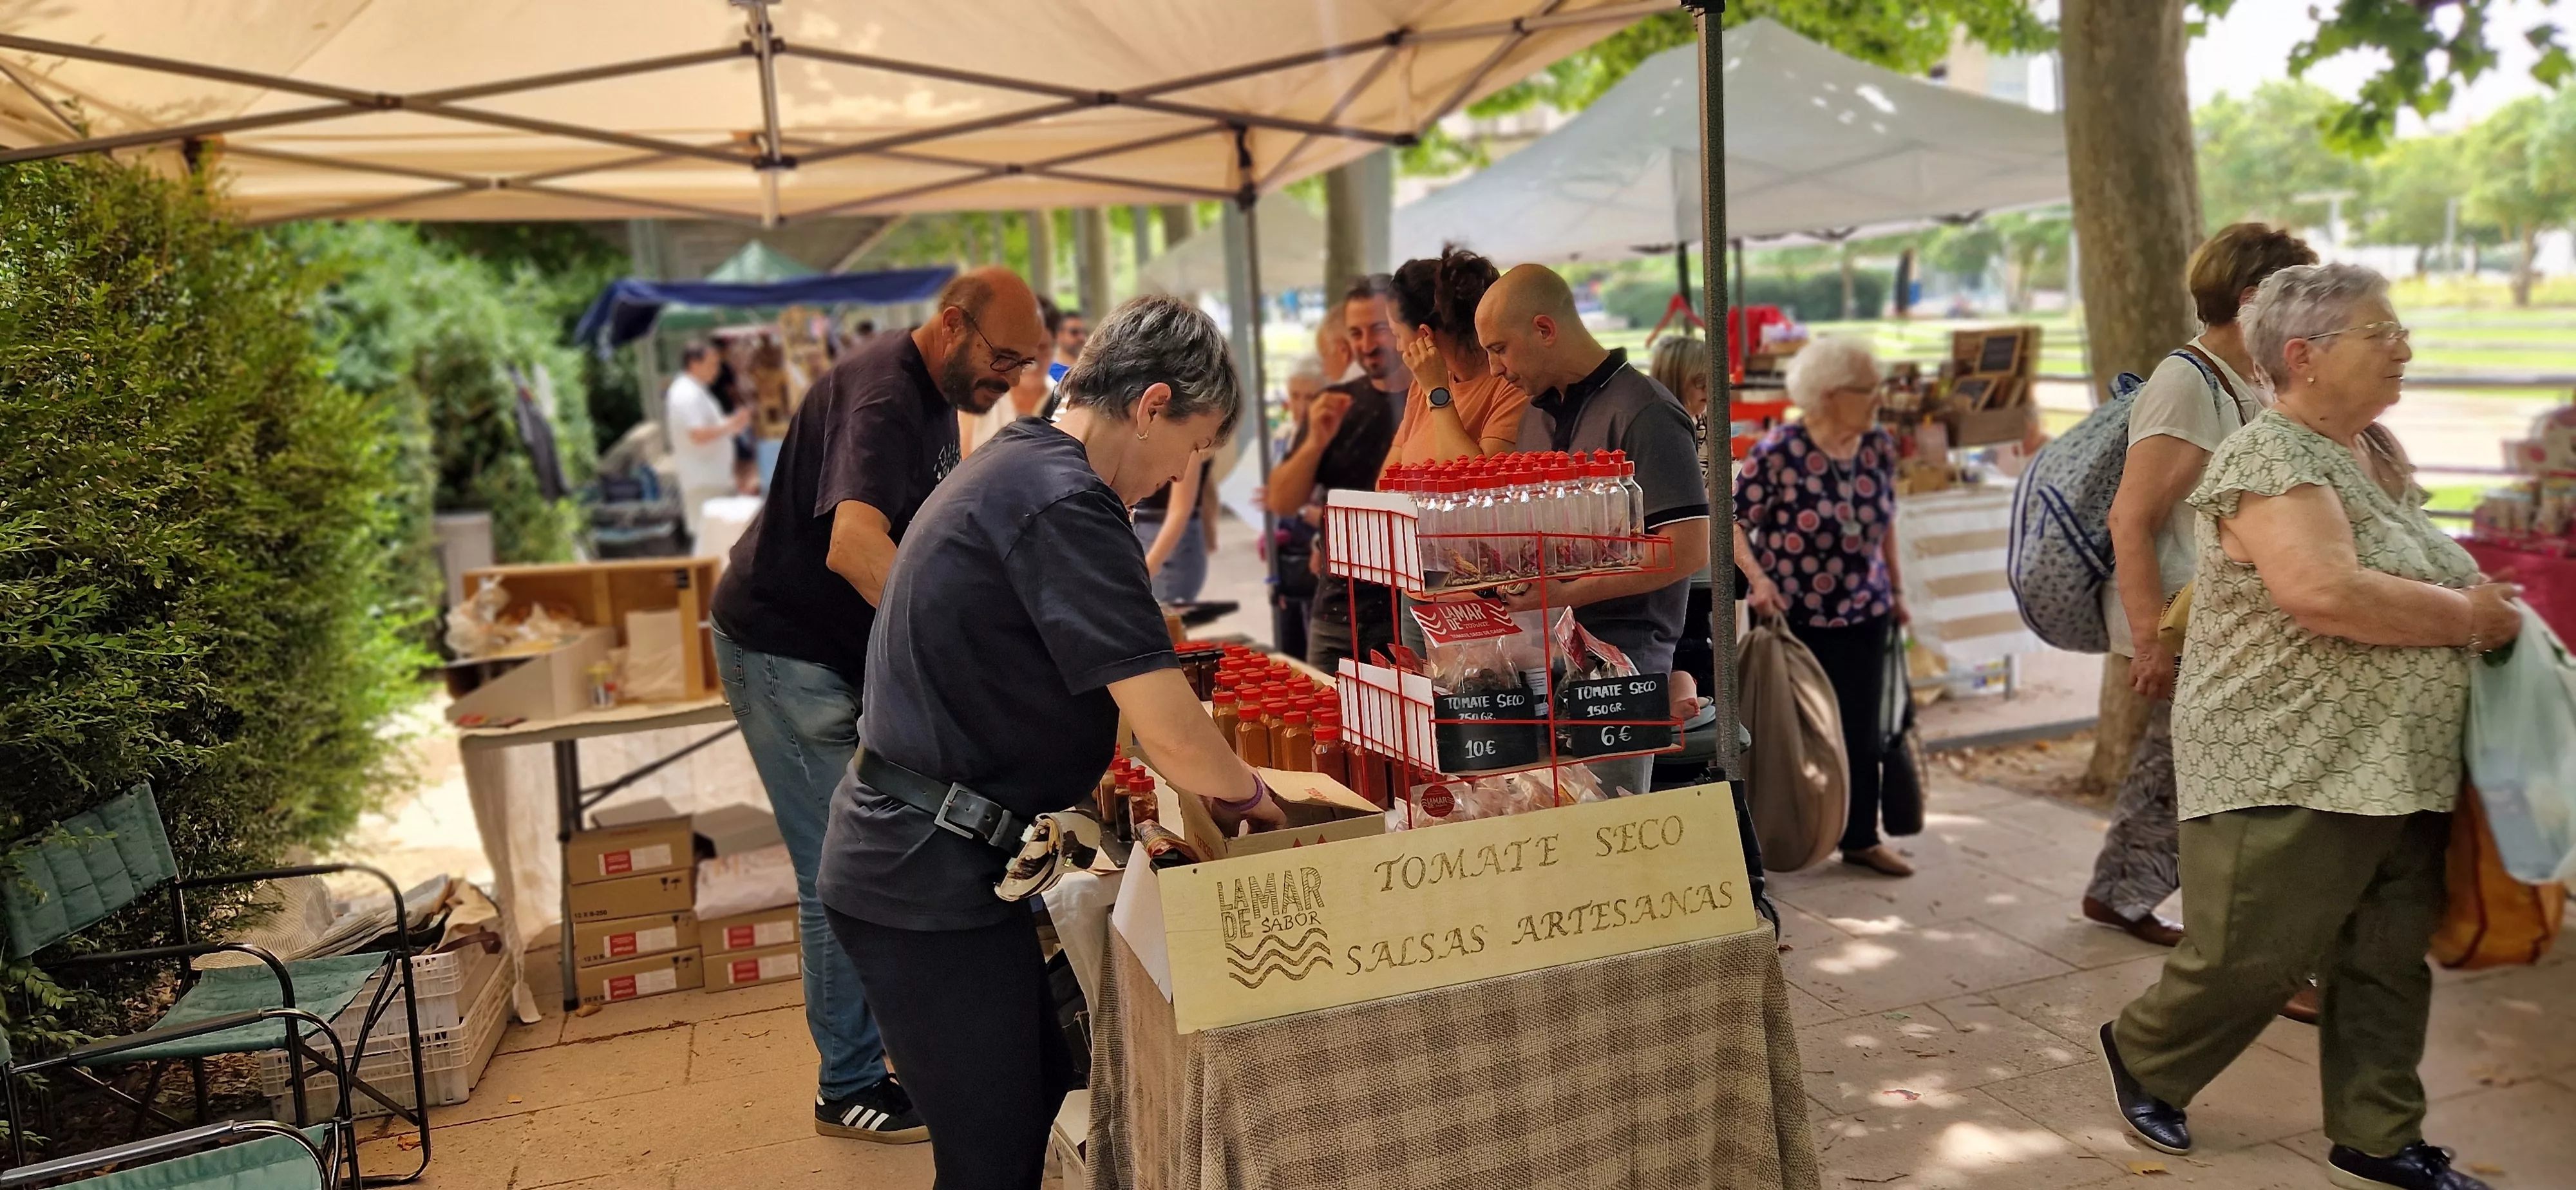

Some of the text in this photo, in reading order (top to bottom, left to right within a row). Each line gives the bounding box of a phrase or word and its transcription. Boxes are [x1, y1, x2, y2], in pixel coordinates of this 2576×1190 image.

[1438, 603, 1487, 622] LAMAR
[1446, 618, 1464, 630] DE
[1575, 681, 1657, 700] TOMATE SECO
[1443, 695, 1490, 710] TOMATE
[1465, 740, 1496, 759] 10€
[1374, 815, 1685, 892] TOMATE SECO
[1217, 867, 1325, 918] LAMAR
[1221, 908, 1321, 943] DE SABOR
[1345, 880, 1733, 976] SALSAS ARTESANAS
